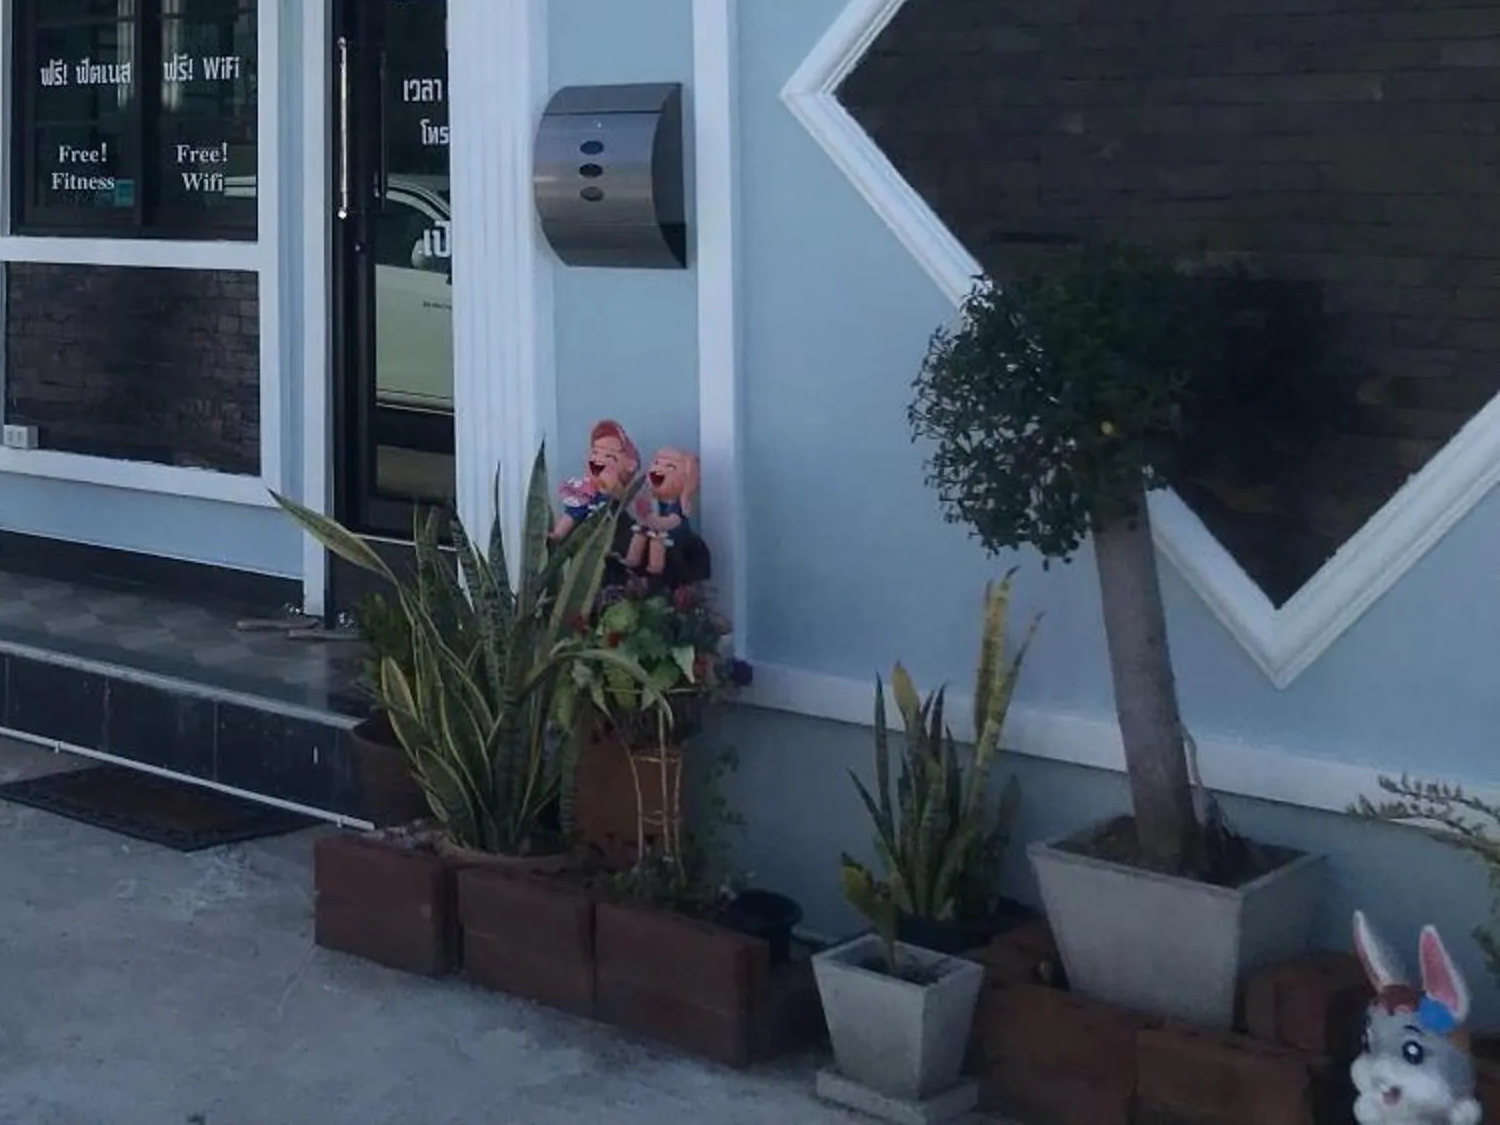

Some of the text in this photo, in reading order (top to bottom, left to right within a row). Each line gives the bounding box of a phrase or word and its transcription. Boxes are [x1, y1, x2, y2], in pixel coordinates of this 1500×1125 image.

[40, 58, 68, 86] ฟรี!
[163, 52, 241, 82] ฟรี! WiFi
[403, 78, 443, 102] เวลา
[58, 141, 108, 164] Free!
[176, 141, 229, 164] Free!
[51, 171, 116, 191] Fitness
[181, 171, 225, 192] Wifi
